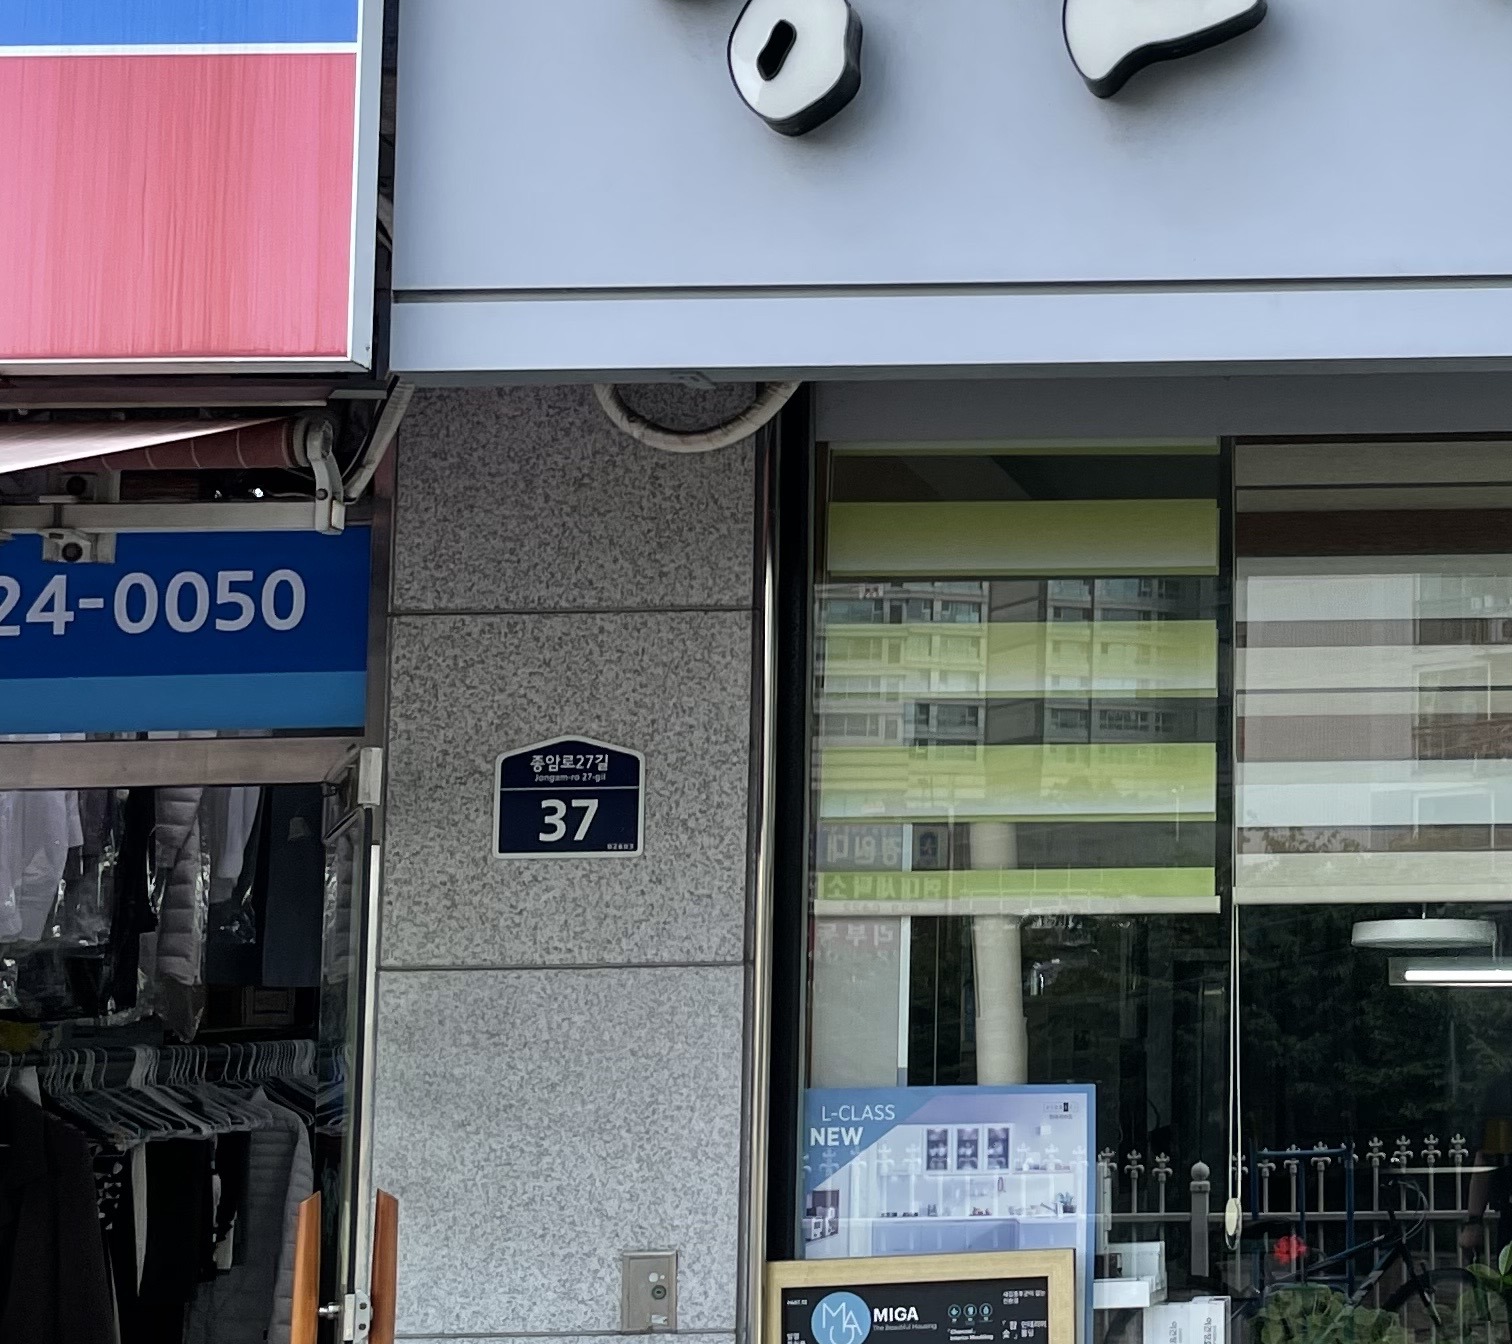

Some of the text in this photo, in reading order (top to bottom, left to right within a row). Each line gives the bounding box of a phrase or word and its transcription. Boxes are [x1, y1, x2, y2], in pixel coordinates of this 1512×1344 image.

[530, 753, 609, 773] 종암로27길
[538, 798, 599, 843] 37
[820, 1104, 896, 1122] L-CLASS
[809, 1126, 864, 1147] NEW
[873, 1306, 920, 1323] MIGA
